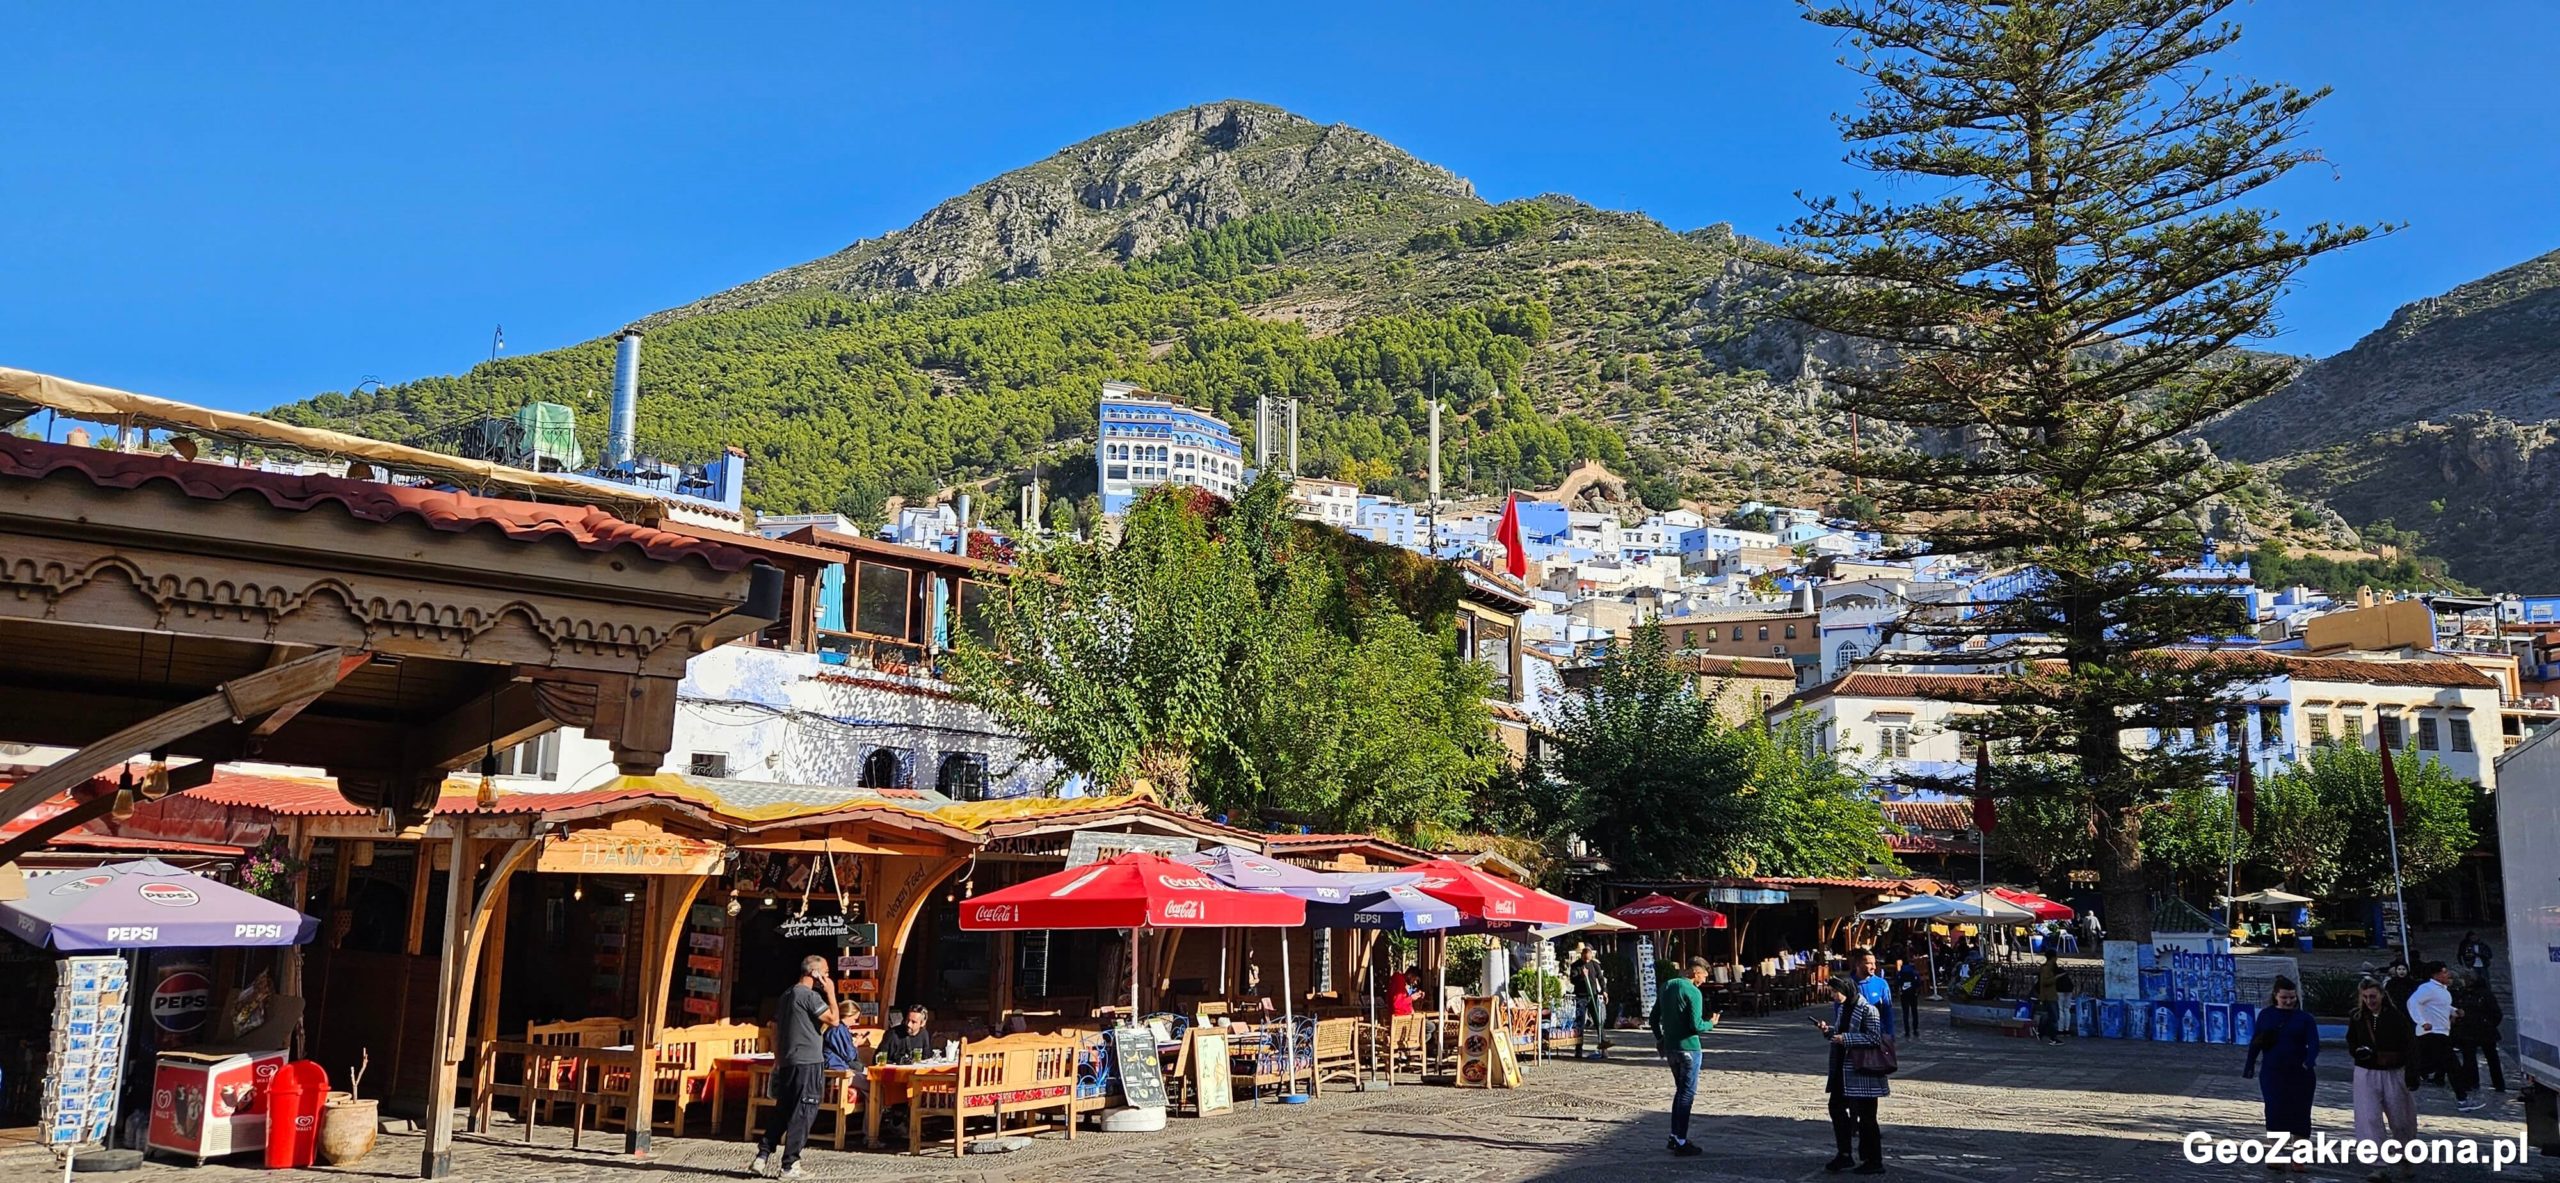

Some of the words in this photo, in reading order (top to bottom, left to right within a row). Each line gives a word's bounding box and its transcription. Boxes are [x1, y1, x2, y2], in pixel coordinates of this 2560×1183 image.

[984, 838, 1065, 854] ESTAURANT
[581, 841, 684, 867] HAMSA
[1353, 913, 1382, 924] PEPSI
[107, 926, 158, 941] PEPSI
[235, 924, 281, 938] PEPSI
[154, 995, 207, 1009] PEPS
